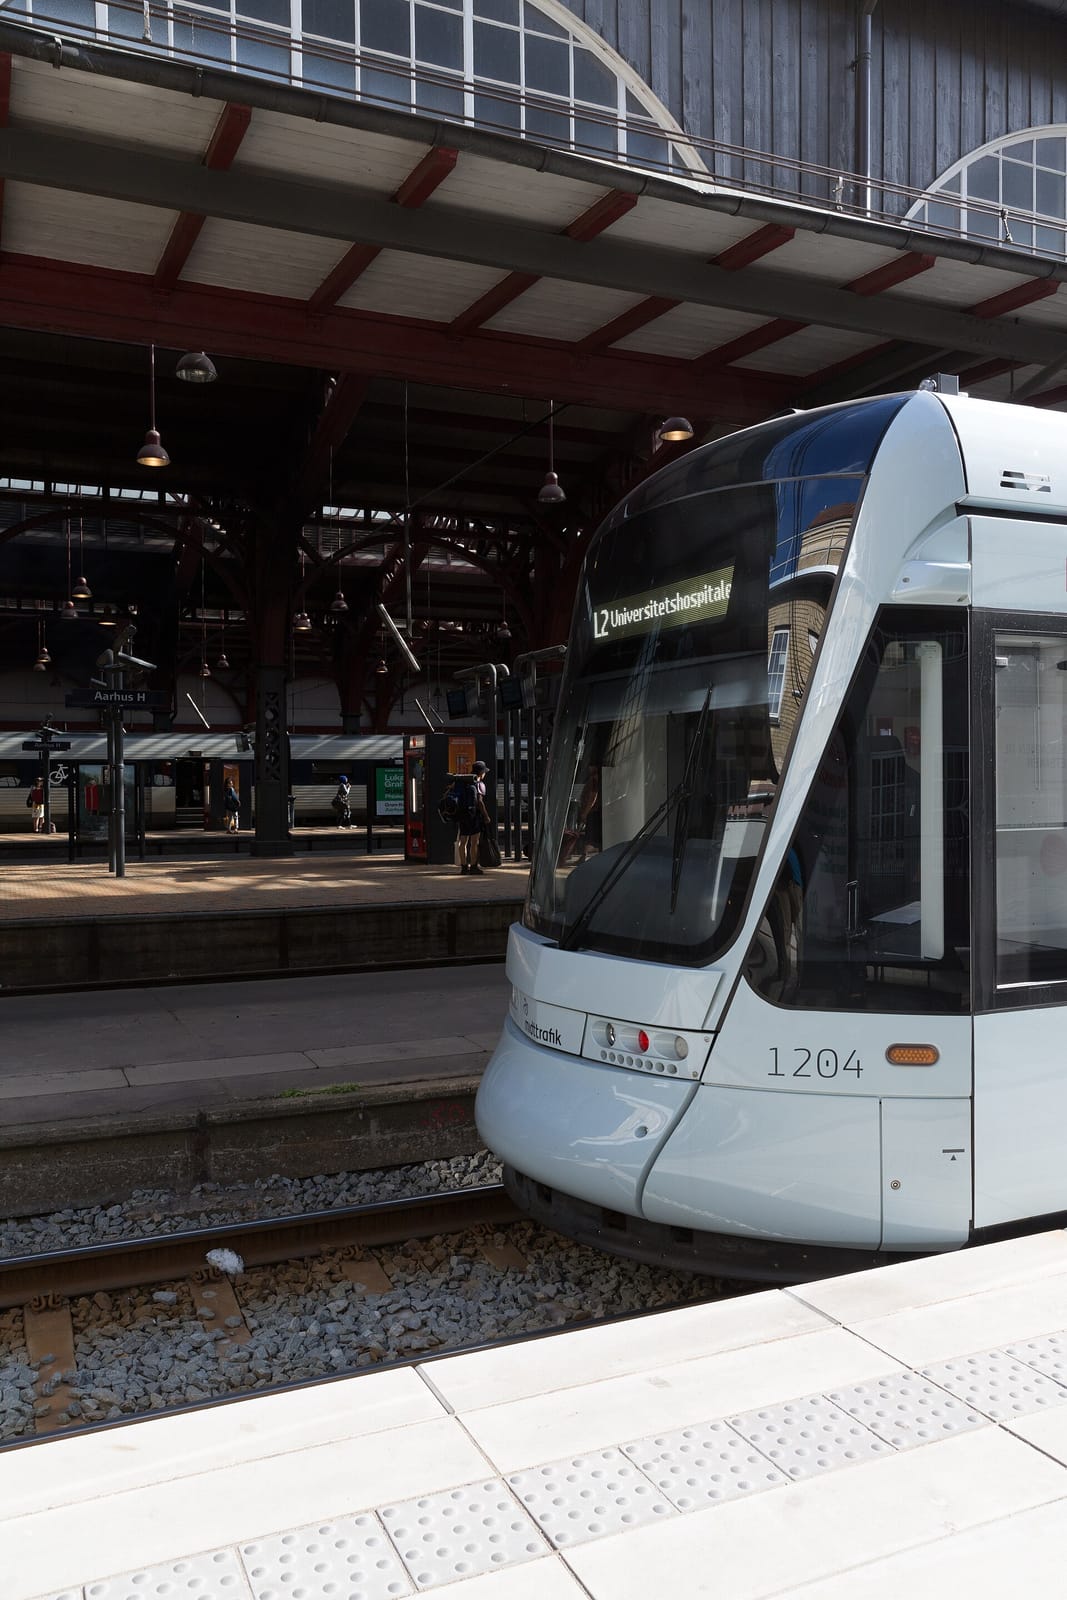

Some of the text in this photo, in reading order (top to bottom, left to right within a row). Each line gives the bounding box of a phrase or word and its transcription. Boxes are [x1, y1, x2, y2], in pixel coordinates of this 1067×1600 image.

[593, 580, 732, 639] L2 Universitetshospitale
[94, 691, 146, 702] Aarhus H
[767, 1046, 864, 1079] 1204
